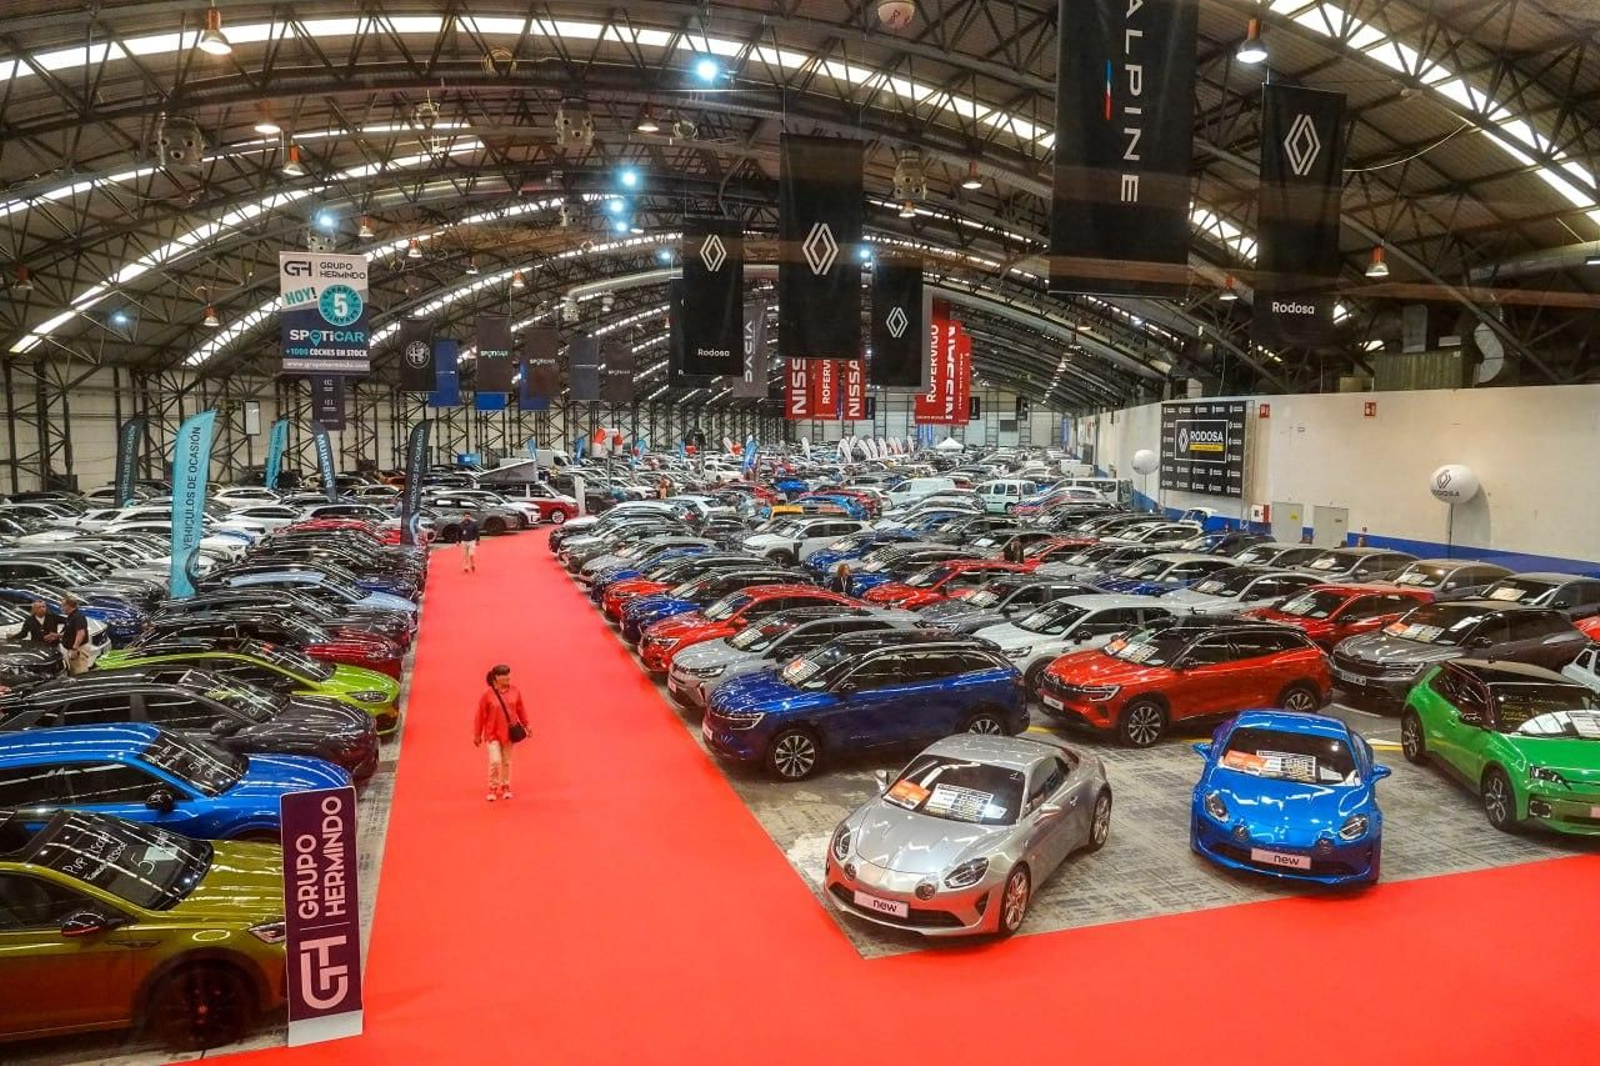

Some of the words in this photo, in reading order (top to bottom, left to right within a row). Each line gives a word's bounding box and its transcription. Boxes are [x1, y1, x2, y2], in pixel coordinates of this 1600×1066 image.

[1120, 0, 1144, 202] ALPINE
[320, 262, 353, 270] GRUPO
[320, 270, 366, 279] HERMINDO
[284, 287, 317, 305] HOY!
[334, 293, 348, 317] 5
[1272, 301, 1315, 315] Rodosa
[309, 348, 335, 357] COCHES
[347, 349, 368, 357] STOCK
[697, 348, 730, 357] Rodosa
[1190, 430, 1223, 442] RODOSA
[188, 426, 201, 473] OCASIÓN
[187, 476, 197, 489] DE
[321, 796, 347, 918] HERMINDO
[1274, 855, 1300, 866] new
[295, 833, 320, 919] GRUPO
[873, 899, 898, 913] new
